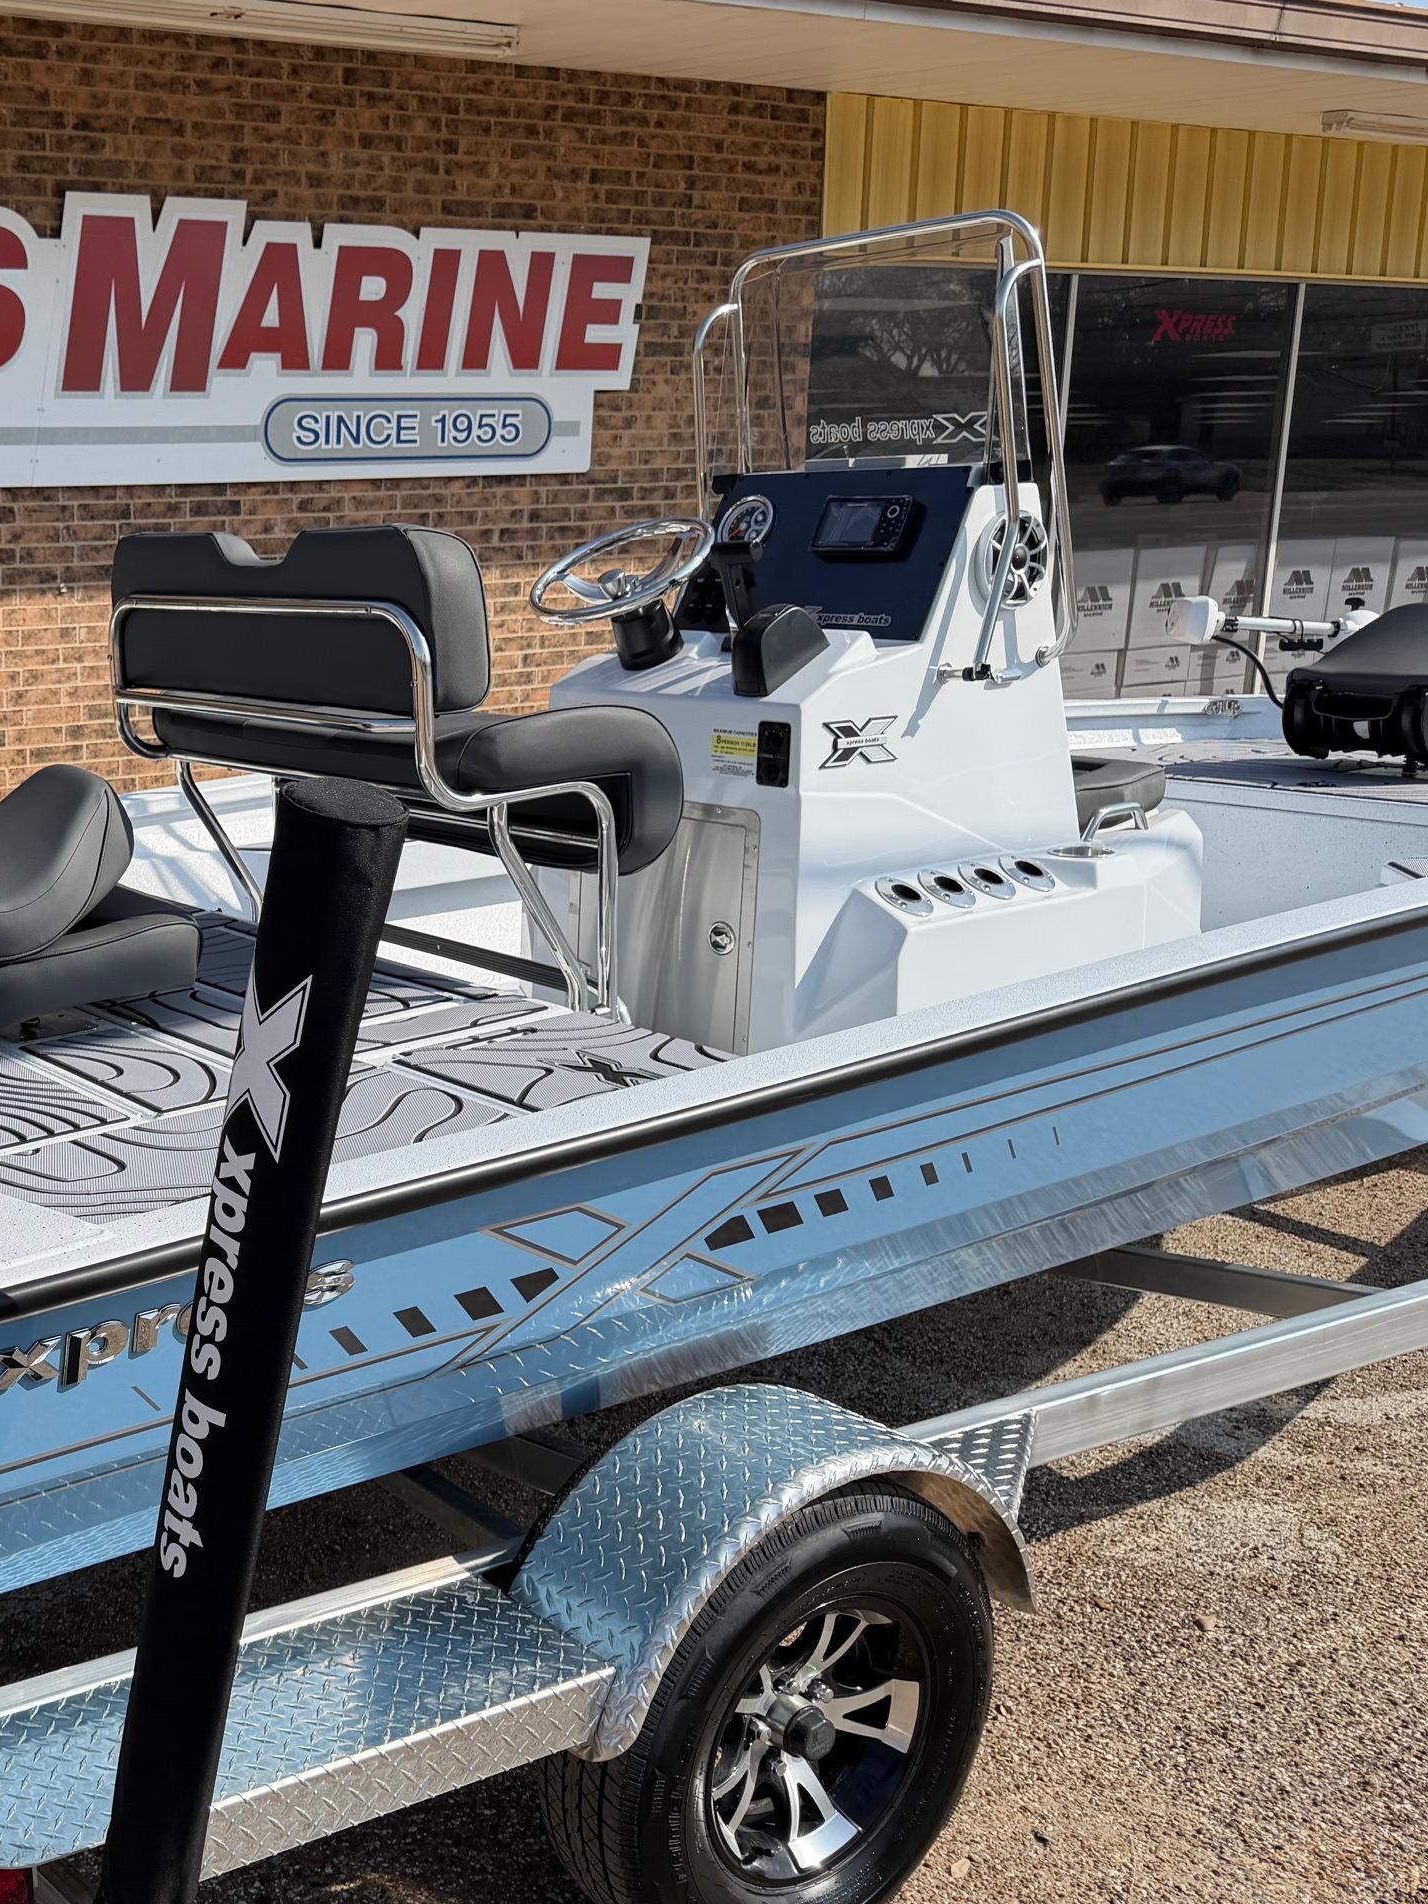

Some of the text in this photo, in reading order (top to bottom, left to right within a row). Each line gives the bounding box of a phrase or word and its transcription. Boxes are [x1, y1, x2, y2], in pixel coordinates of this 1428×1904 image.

[61, 214, 635, 393] MARINE
[1153, 310, 1237, 342] XPRESS
[293, 410, 523, 448] SINCE 1955
[161, 1137, 258, 1579] xpress boats
